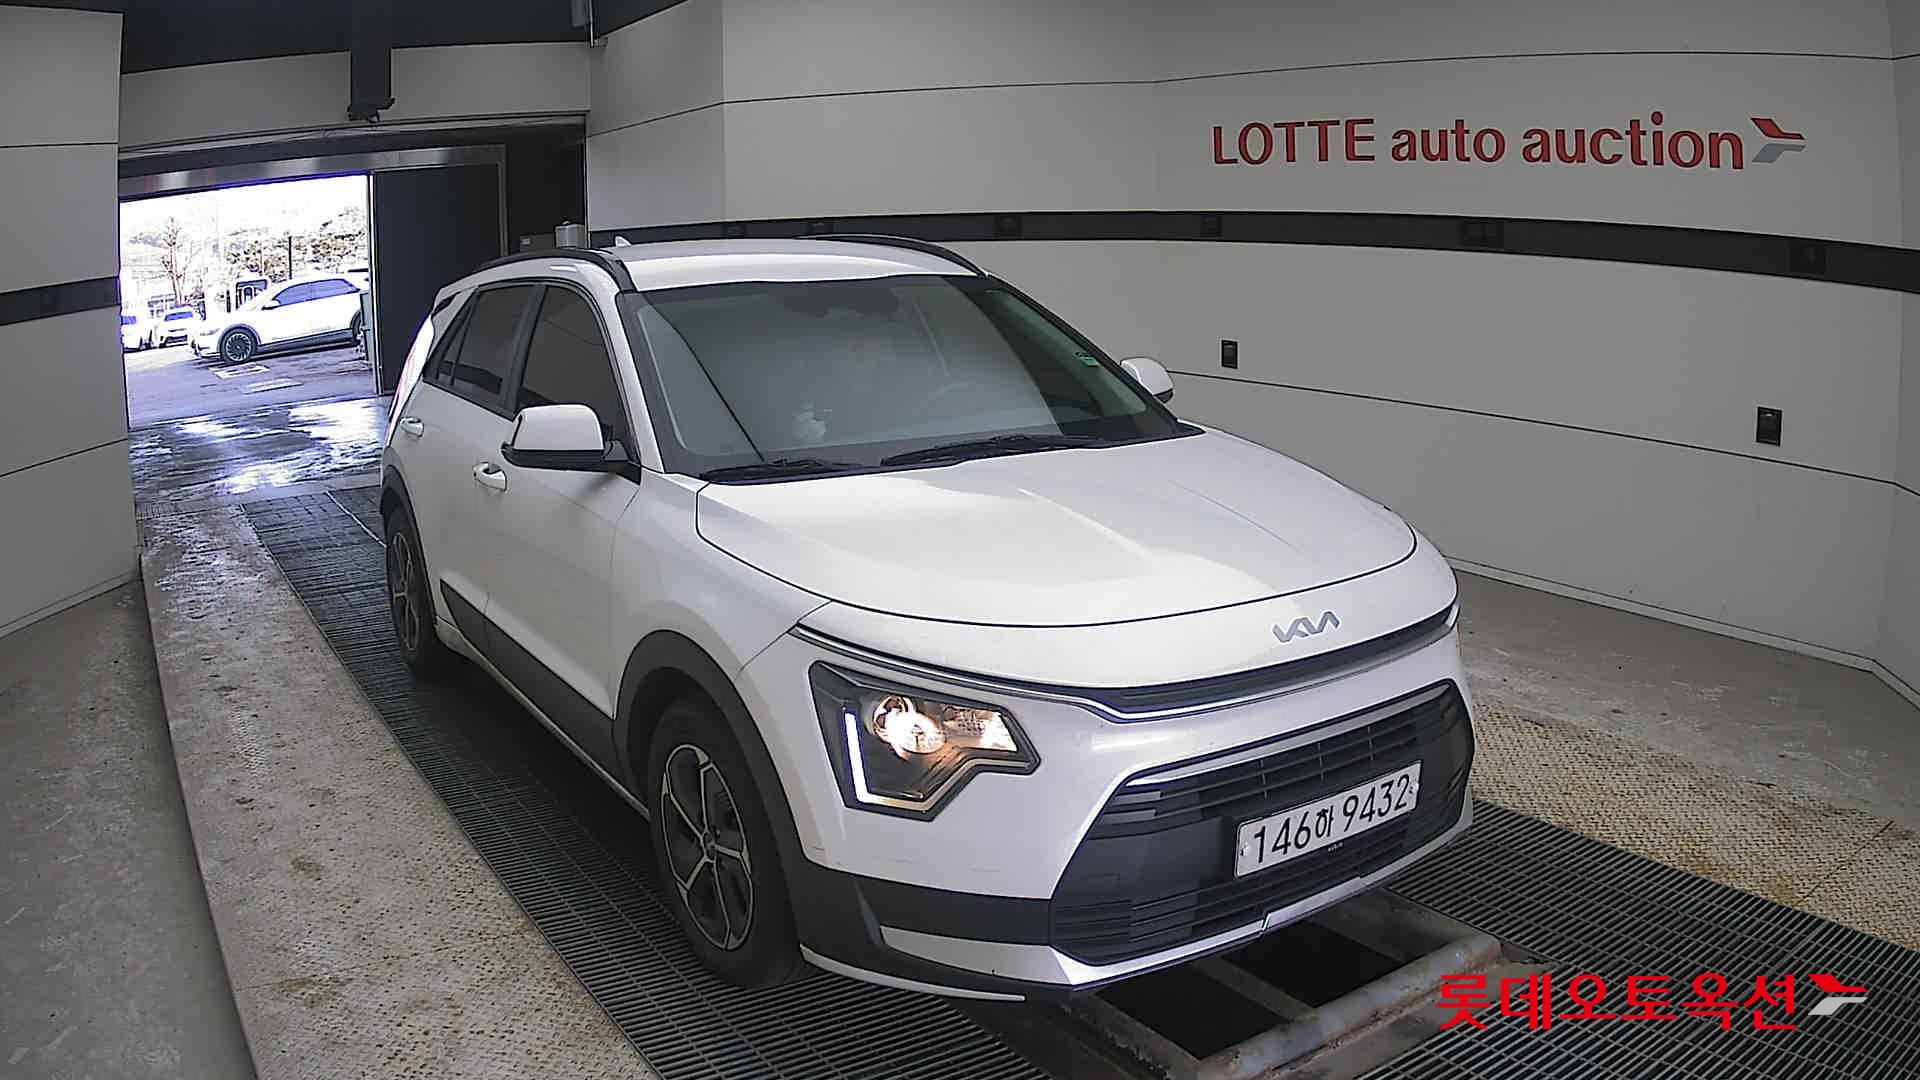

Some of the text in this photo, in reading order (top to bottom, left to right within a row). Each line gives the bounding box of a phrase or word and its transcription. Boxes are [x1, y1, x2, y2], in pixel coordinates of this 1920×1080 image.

[1213, 111, 1744, 169] LOTTE auto auction
[1272, 611, 1340, 643] KIA
[1254, 774, 1410, 864] 146하 9432
